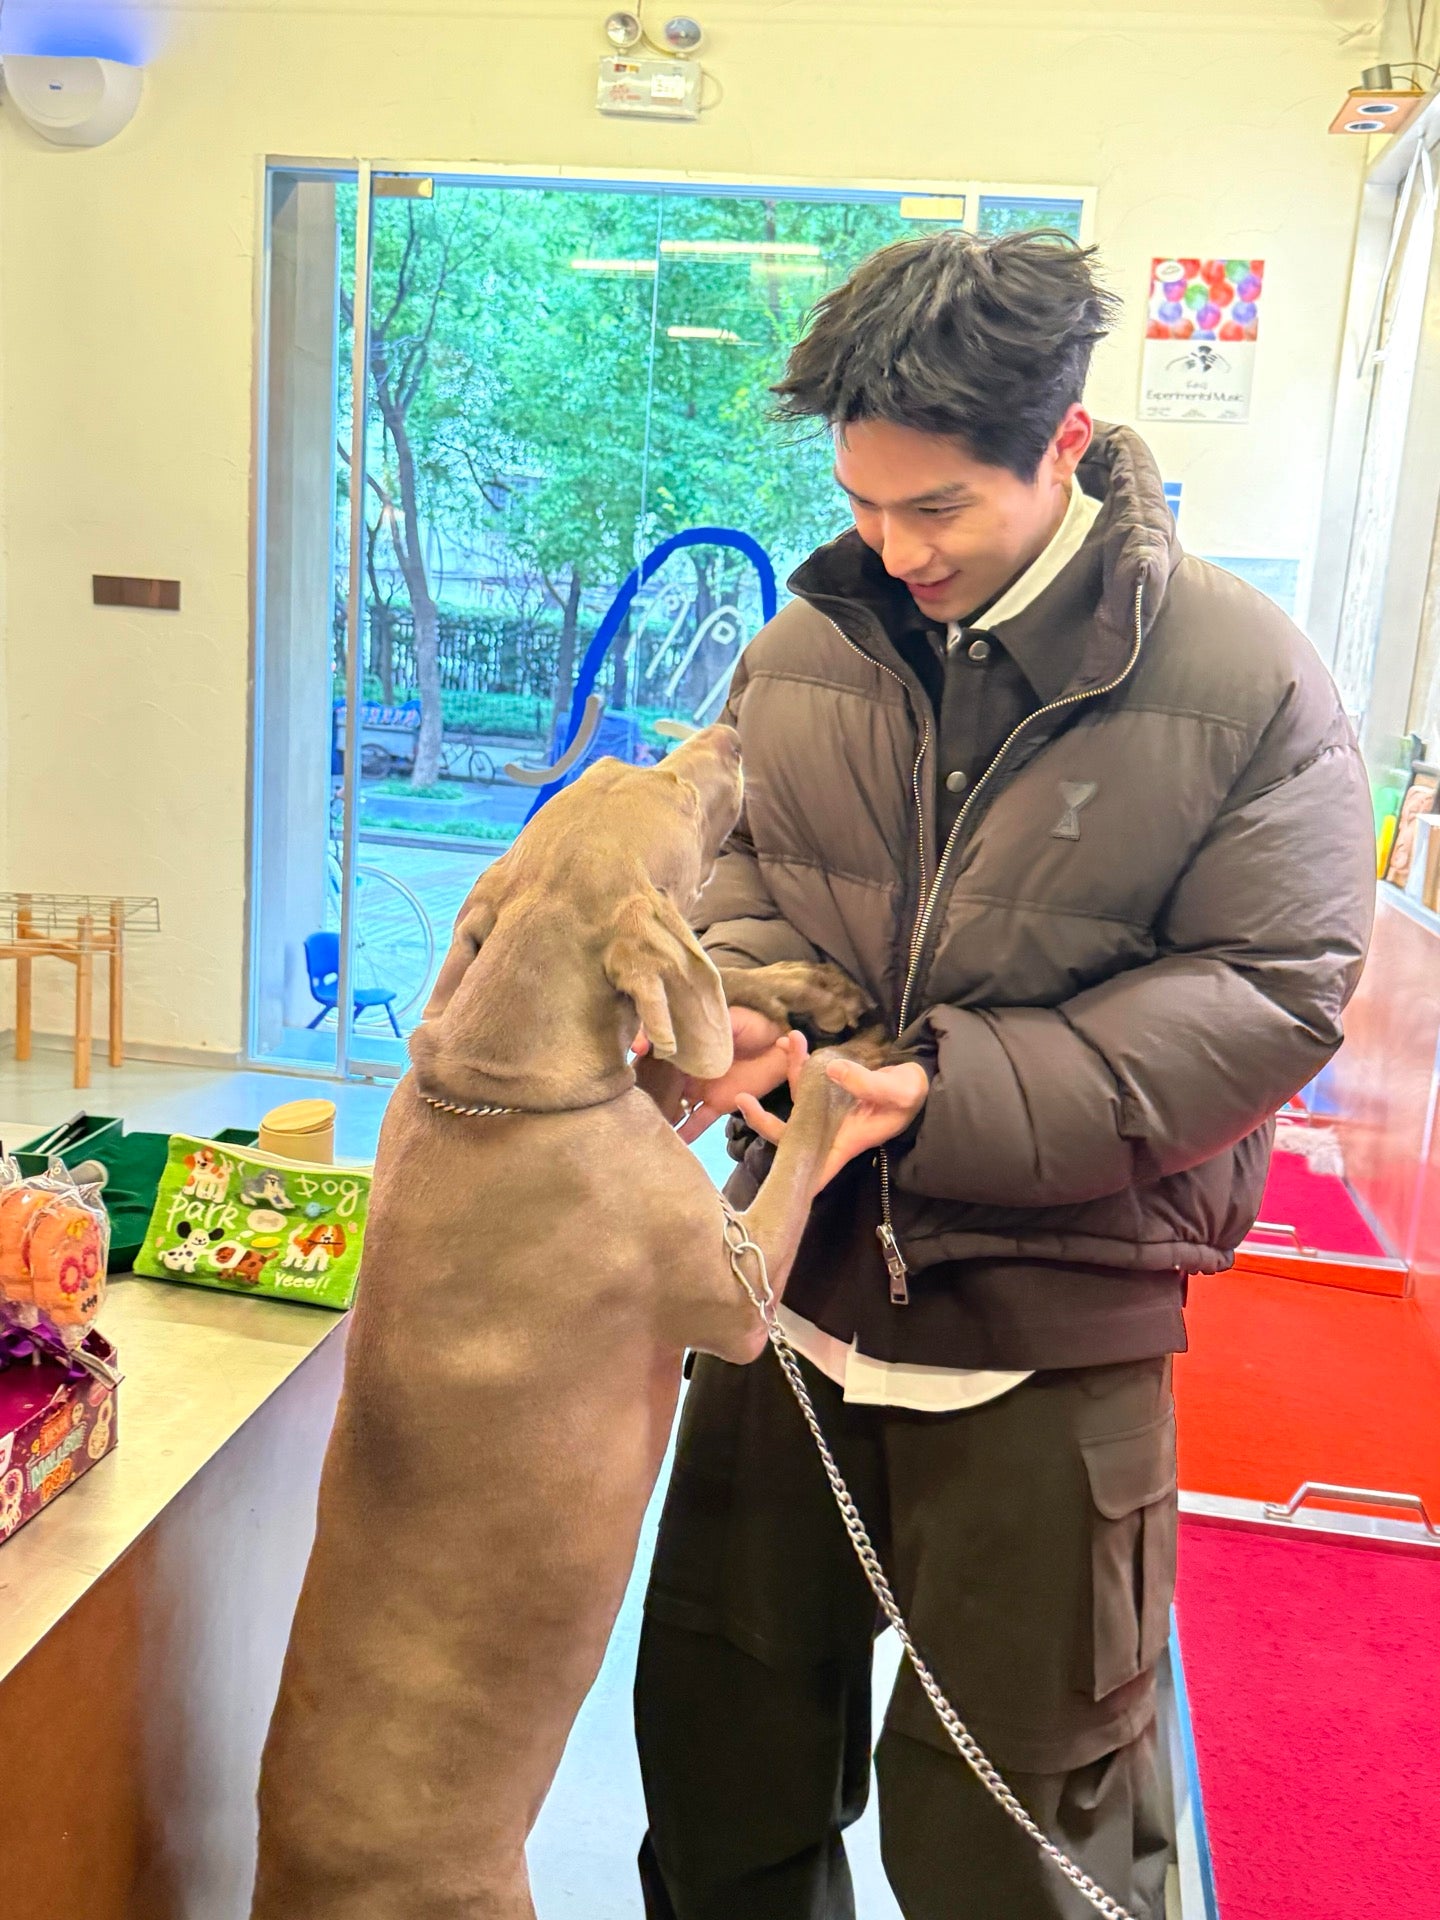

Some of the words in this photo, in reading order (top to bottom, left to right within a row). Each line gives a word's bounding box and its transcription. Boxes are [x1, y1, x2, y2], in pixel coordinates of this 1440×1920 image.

[1146, 390, 1212, 401] Experimental
[1213, 392, 1245, 402] Music
[294, 1174, 364, 1217] Dog
